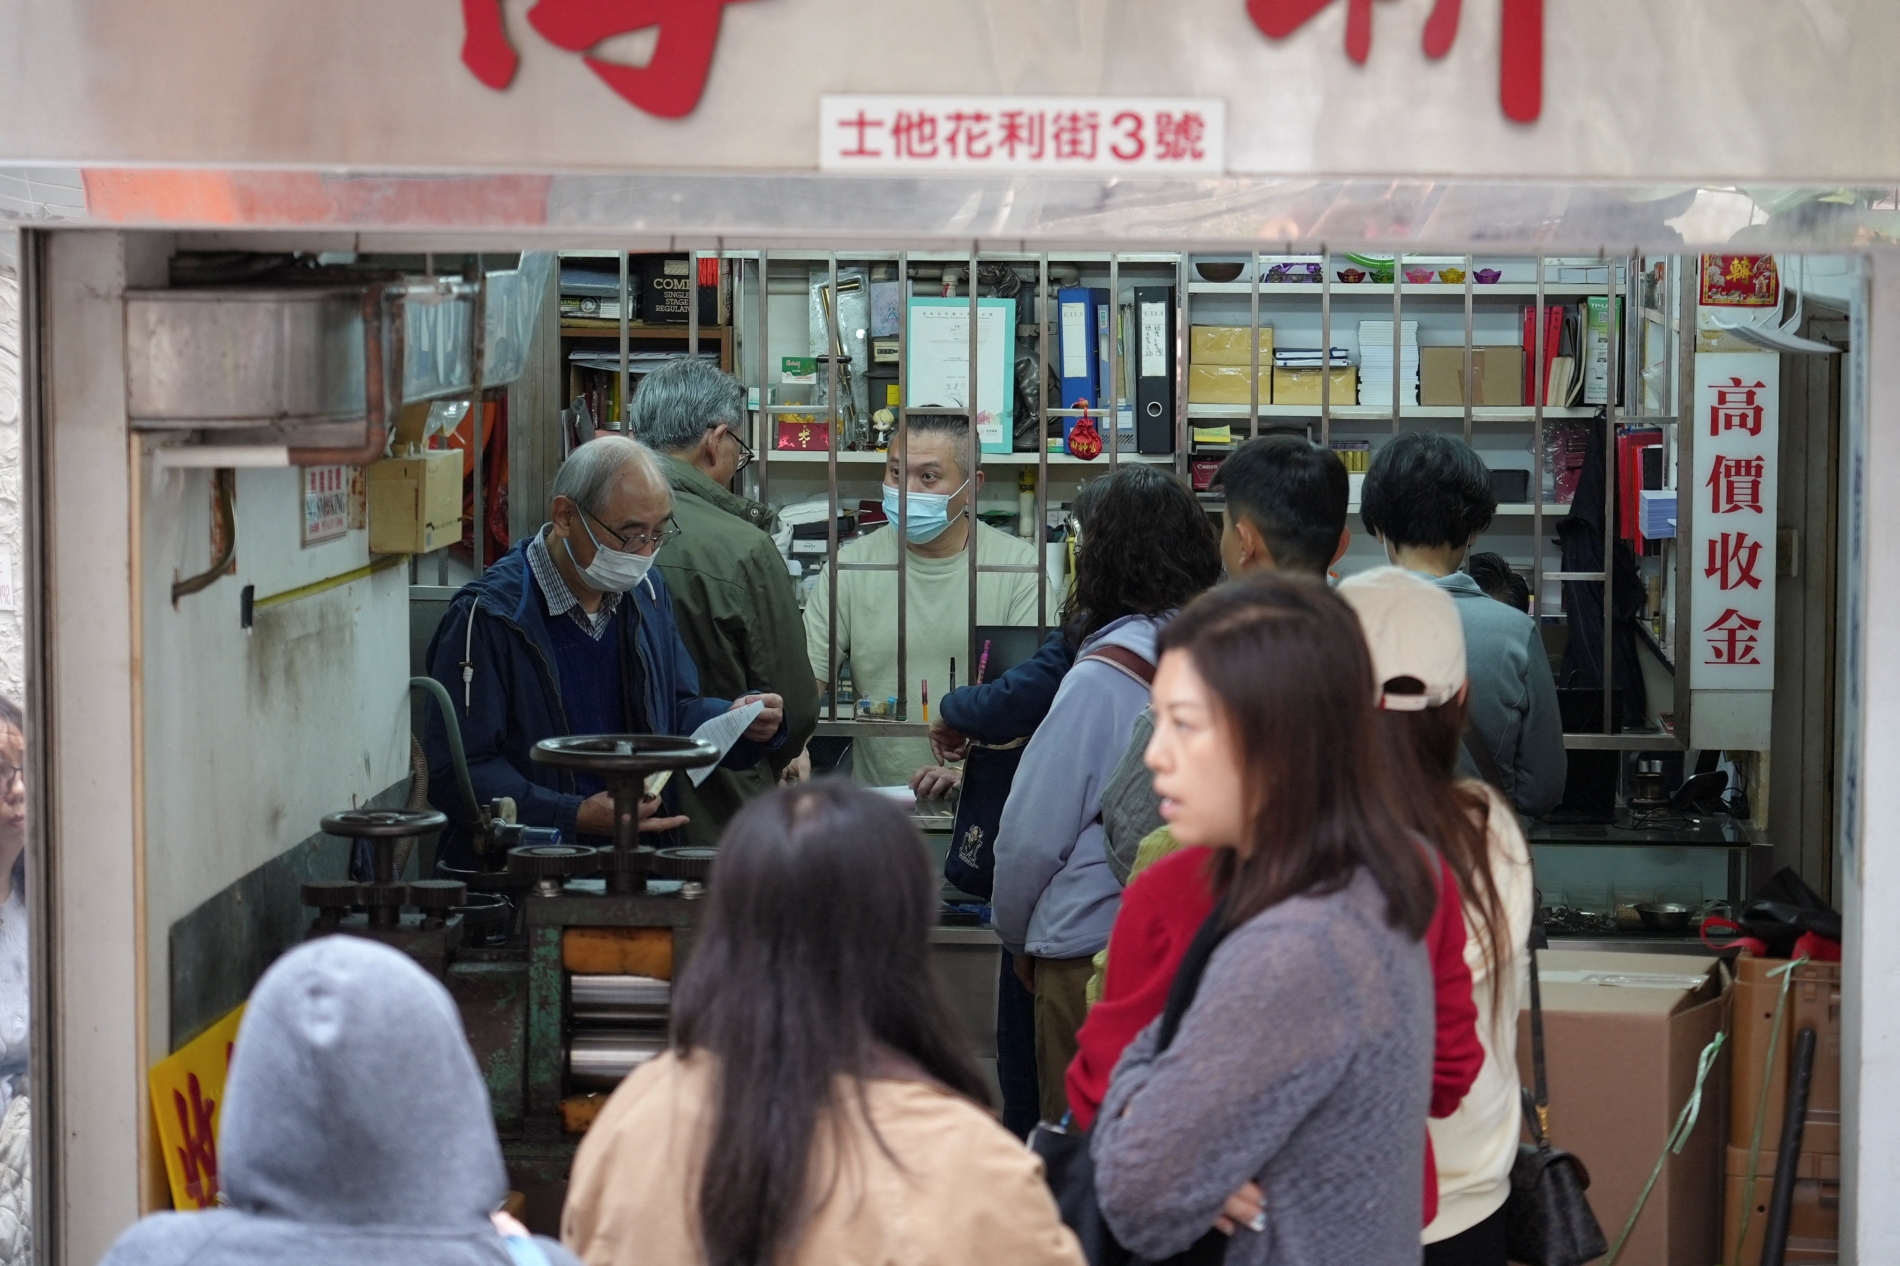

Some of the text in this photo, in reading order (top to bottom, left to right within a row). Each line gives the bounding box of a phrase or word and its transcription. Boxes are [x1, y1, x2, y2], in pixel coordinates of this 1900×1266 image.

[837, 110, 1205, 162] 士他花利街3號
[664, 291, 690, 299] SINGLE
[665, 298, 689, 306] STAGE
[655, 305, 691, 313] REGULAT
[1703, 376, 1766, 666] 高價收金
